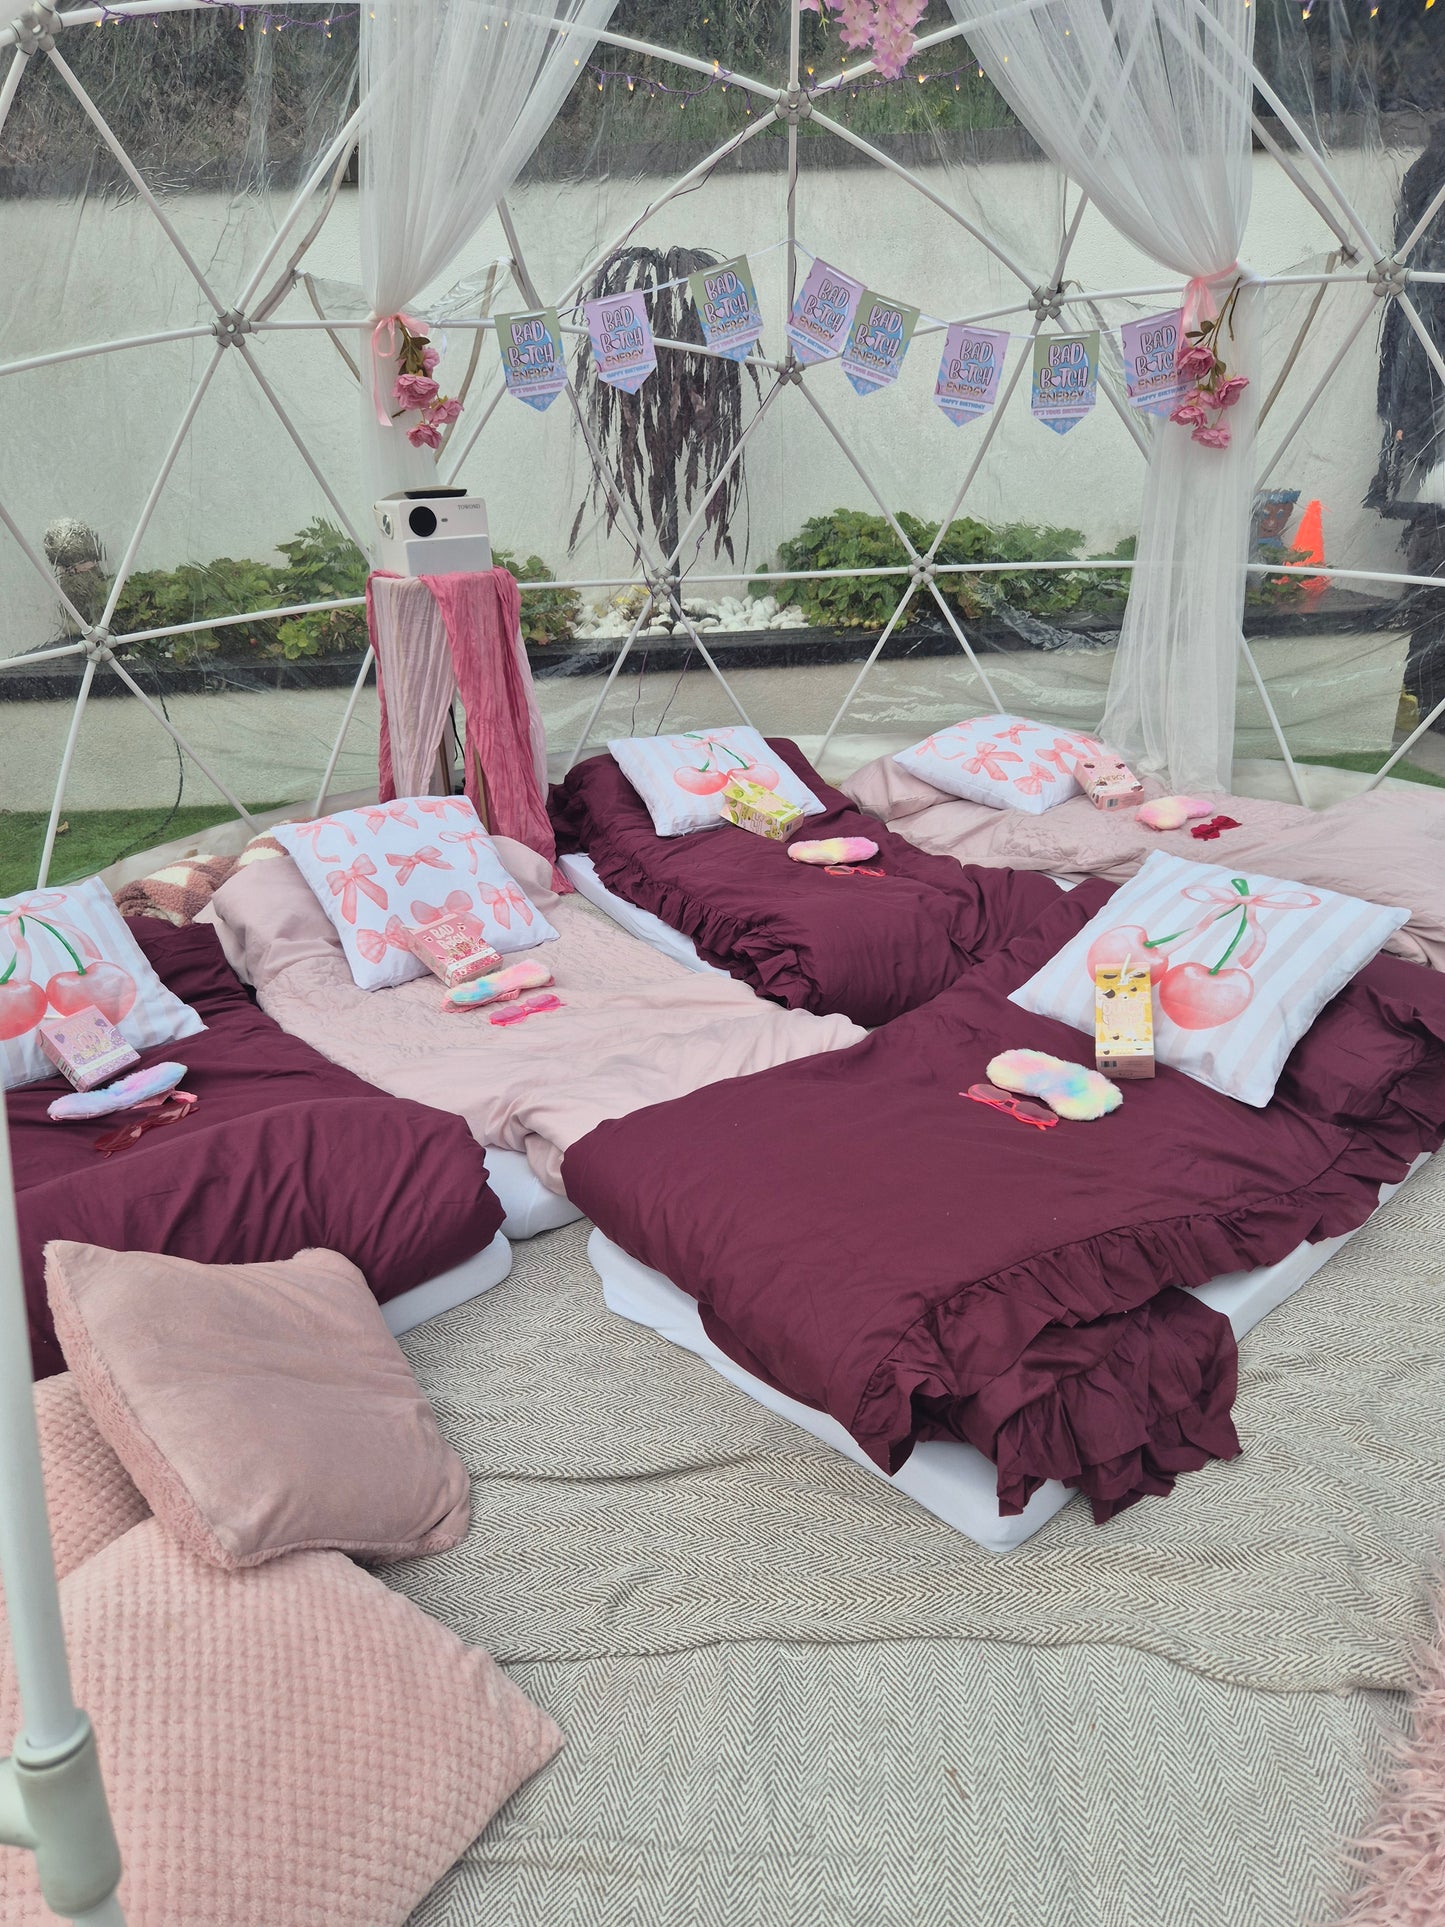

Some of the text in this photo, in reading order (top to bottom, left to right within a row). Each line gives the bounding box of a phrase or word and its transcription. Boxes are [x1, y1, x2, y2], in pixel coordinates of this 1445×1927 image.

[704, 271, 737, 301] BAD
[818, 279, 850, 308] BAD
[602, 305, 634, 332] BAD
[710, 315, 750, 337] ENERGY
[799, 316, 834, 341] ENERGY
[869, 305, 903, 333] BAD
[511, 320, 545, 345] BAD
[791, 329, 807, 340] HAPPY
[1140, 325, 1176, 355] BAD
[606, 349, 644, 366] ENERGY
[850, 346, 891, 366] ENERGY
[960, 339, 993, 363] BAD
[1049, 342, 1084, 367] BAD
[512, 366, 554, 381] ENERGY
[607, 370, 624, 378] HAPPY
[946, 382, 986, 396] ENERGY
[1040, 391, 1084, 403] ENERGY
[959, 400, 985, 410] BIRTHDAY
[429, 924, 454, 938] BAD
